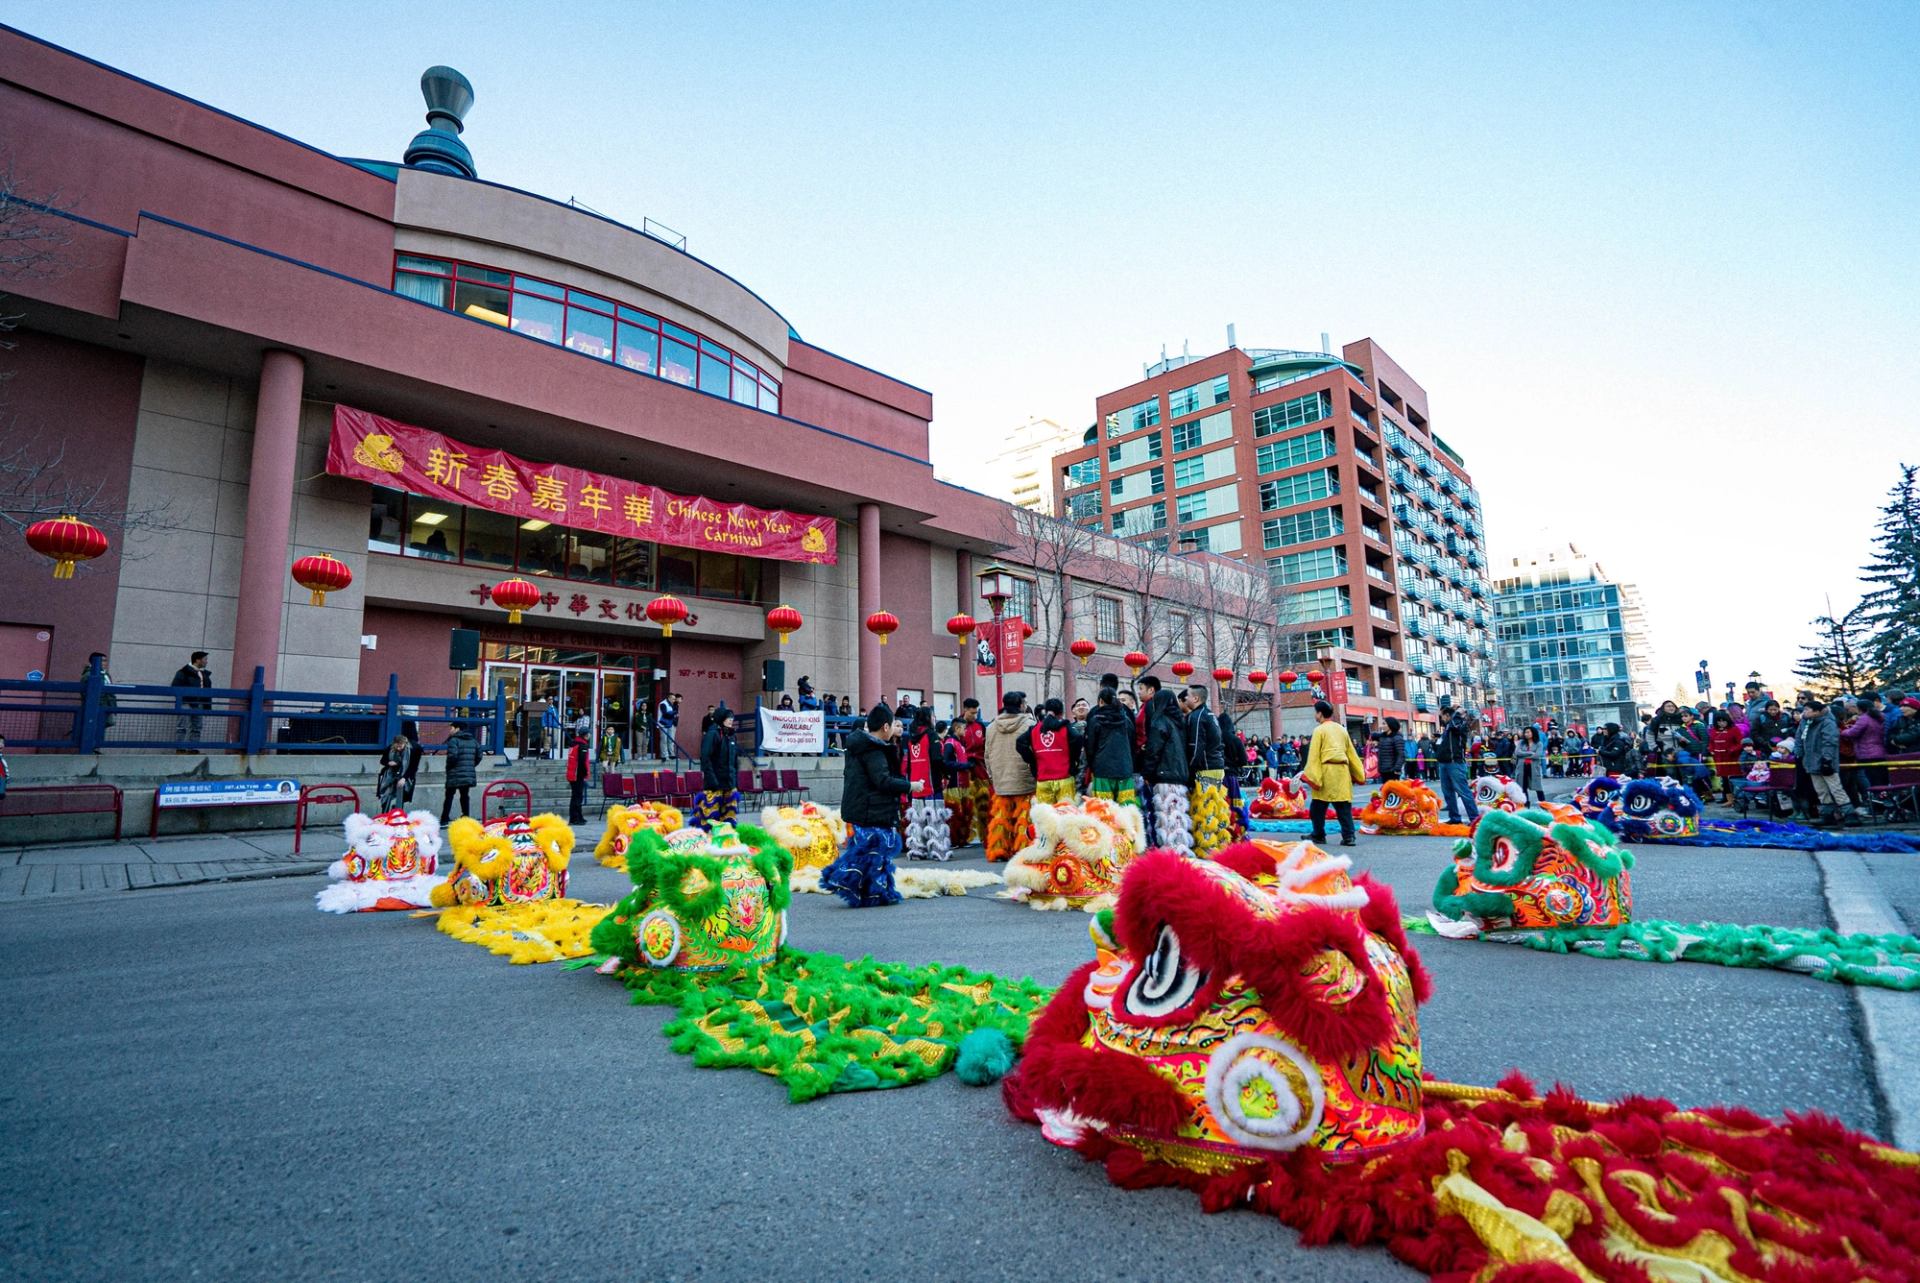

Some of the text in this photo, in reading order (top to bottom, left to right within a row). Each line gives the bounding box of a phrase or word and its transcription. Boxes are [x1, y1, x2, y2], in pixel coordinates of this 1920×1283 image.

[425, 447, 654, 528] 新春嘉年華
[667, 501, 791, 534] Chinese New Year
[704, 526, 762, 547] Carnival
[470, 583, 698, 627] 卡中華文化心
